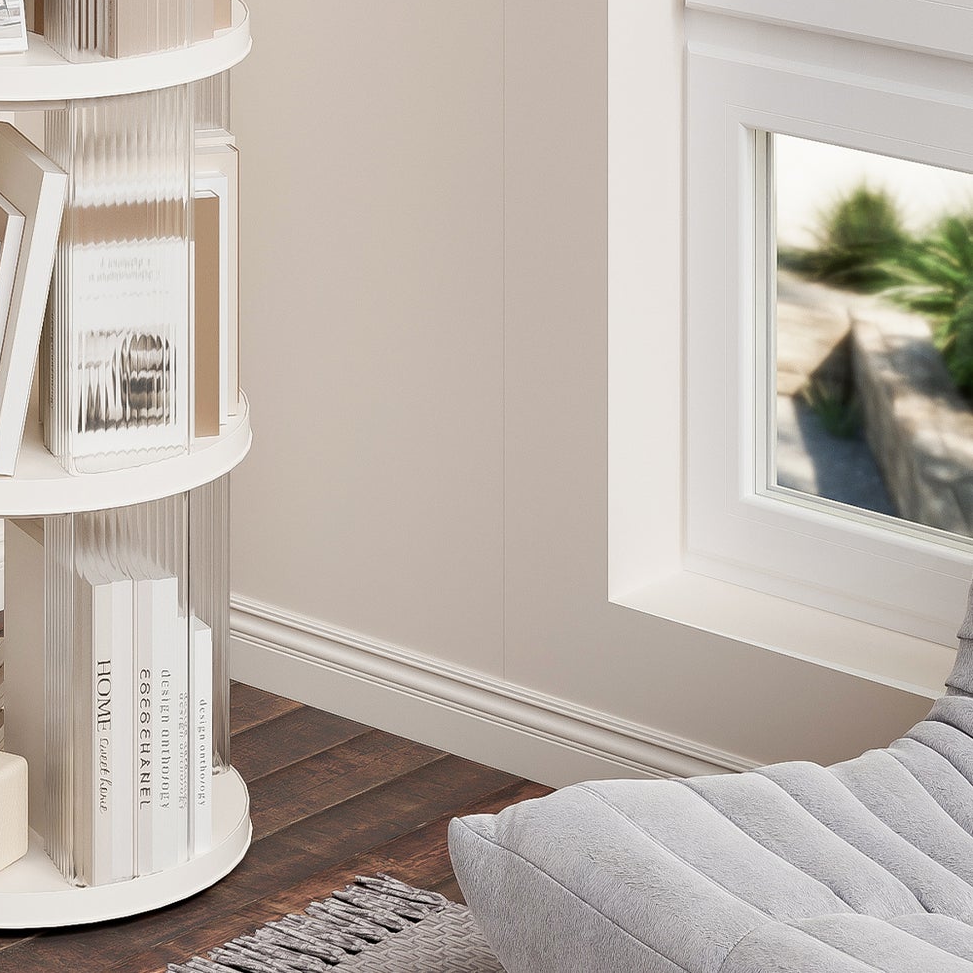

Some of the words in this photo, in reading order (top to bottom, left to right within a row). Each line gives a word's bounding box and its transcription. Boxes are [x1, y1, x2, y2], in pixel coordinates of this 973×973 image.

[97, 659, 111, 732] HOME
[159, 668, 171, 723] design
[197, 698, 208, 741] design
[197, 744, 208, 806] anthology
